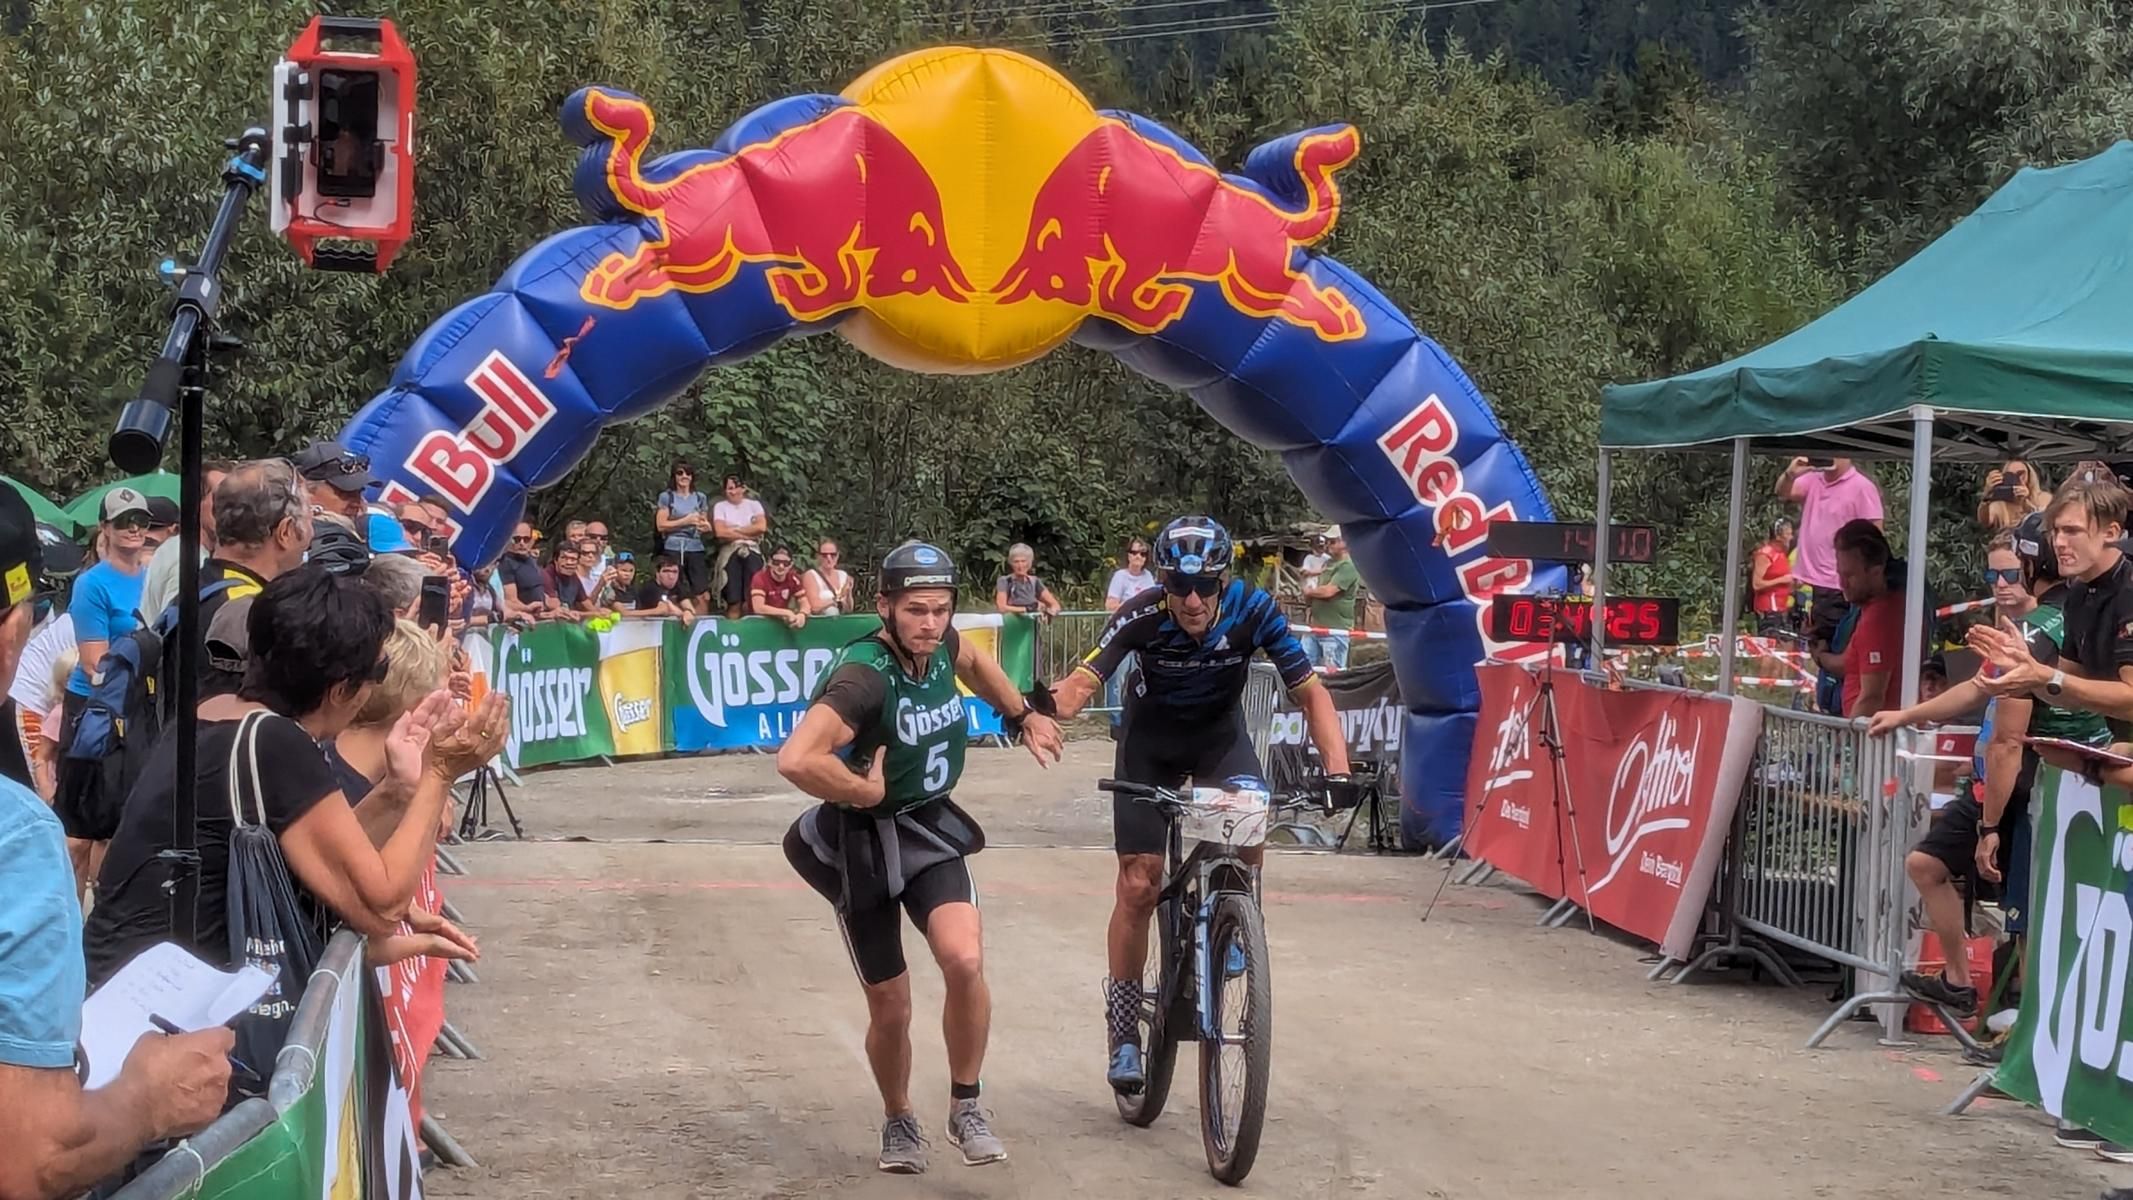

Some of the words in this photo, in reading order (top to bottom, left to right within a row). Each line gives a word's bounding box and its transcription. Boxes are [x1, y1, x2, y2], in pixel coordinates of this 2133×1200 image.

[404, 350, 557, 515] Bull
[1377, 394, 1519, 557] Red
[497, 630, 593, 770] Gösser
[686, 618, 842, 728] Gösse
[897, 696, 963, 746] Gösser
[923, 741, 950, 792] 5
[1221, 819, 1235, 839] 5
